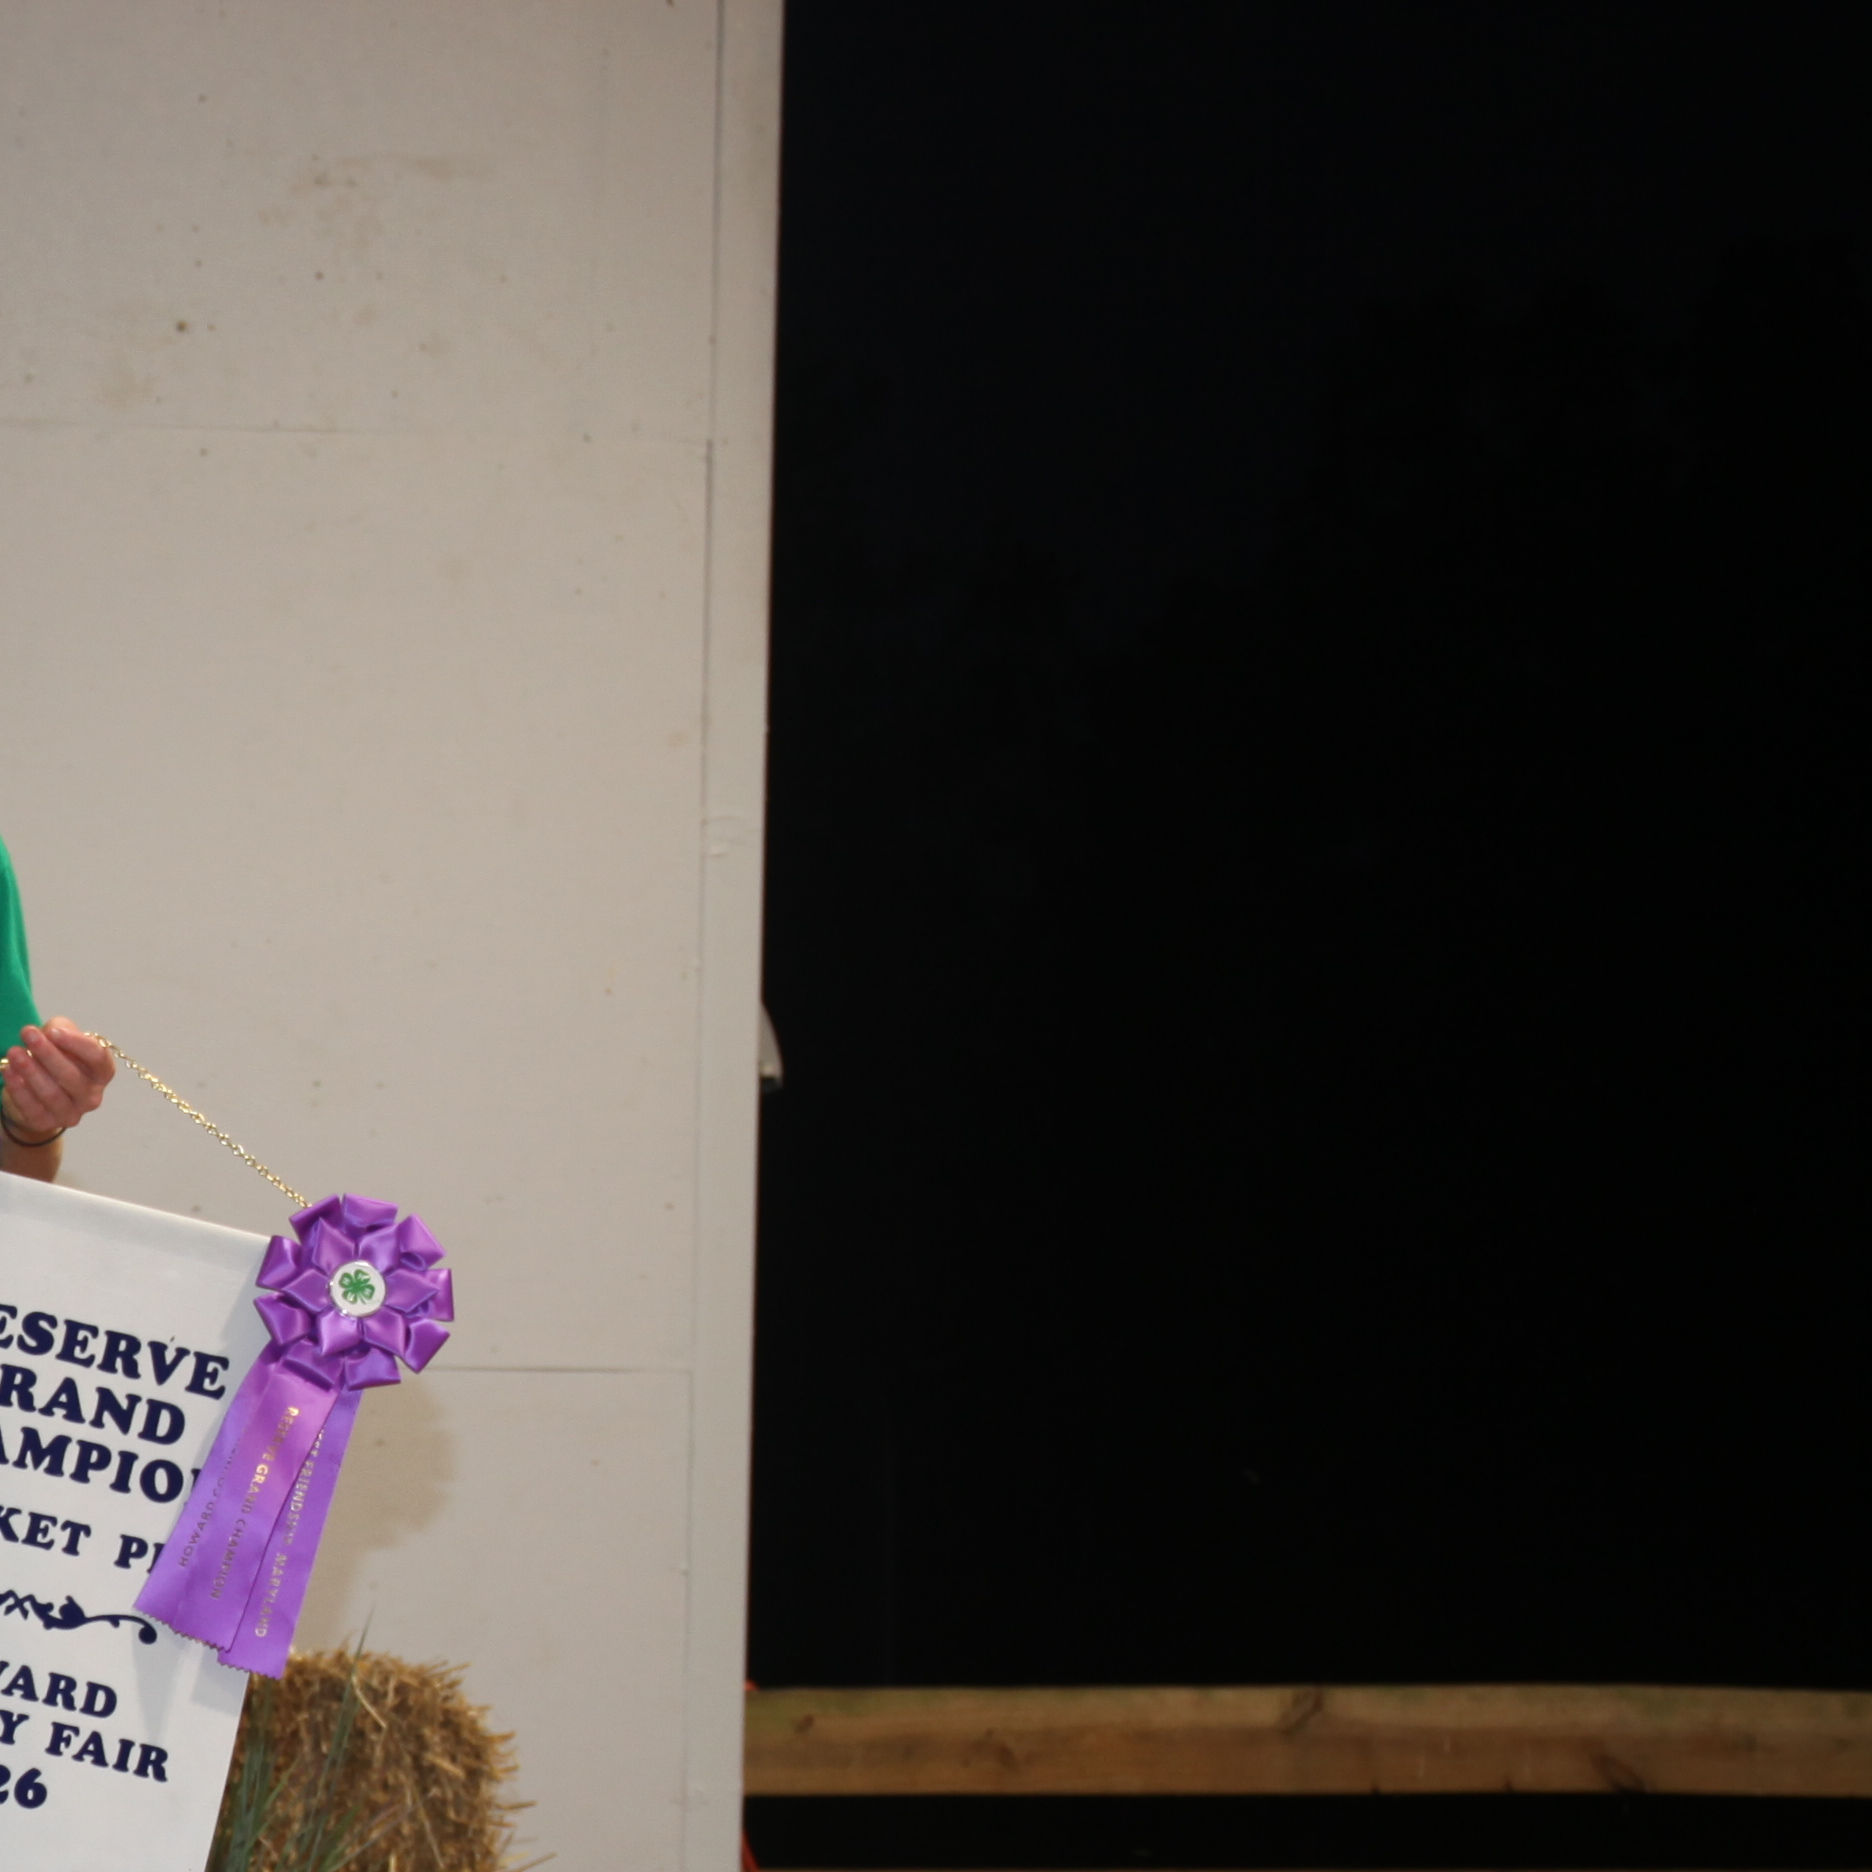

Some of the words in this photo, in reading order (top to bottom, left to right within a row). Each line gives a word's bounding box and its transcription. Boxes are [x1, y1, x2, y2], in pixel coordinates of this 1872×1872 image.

[241, 1463, 269, 1515] GRAND
[180, 1501, 214, 1568] HOWARD
[209, 1518, 246, 1601] CHAMPION
[255, 1552, 287, 1639] MARYLAND
[44, 1721, 170, 1783] FAIR
